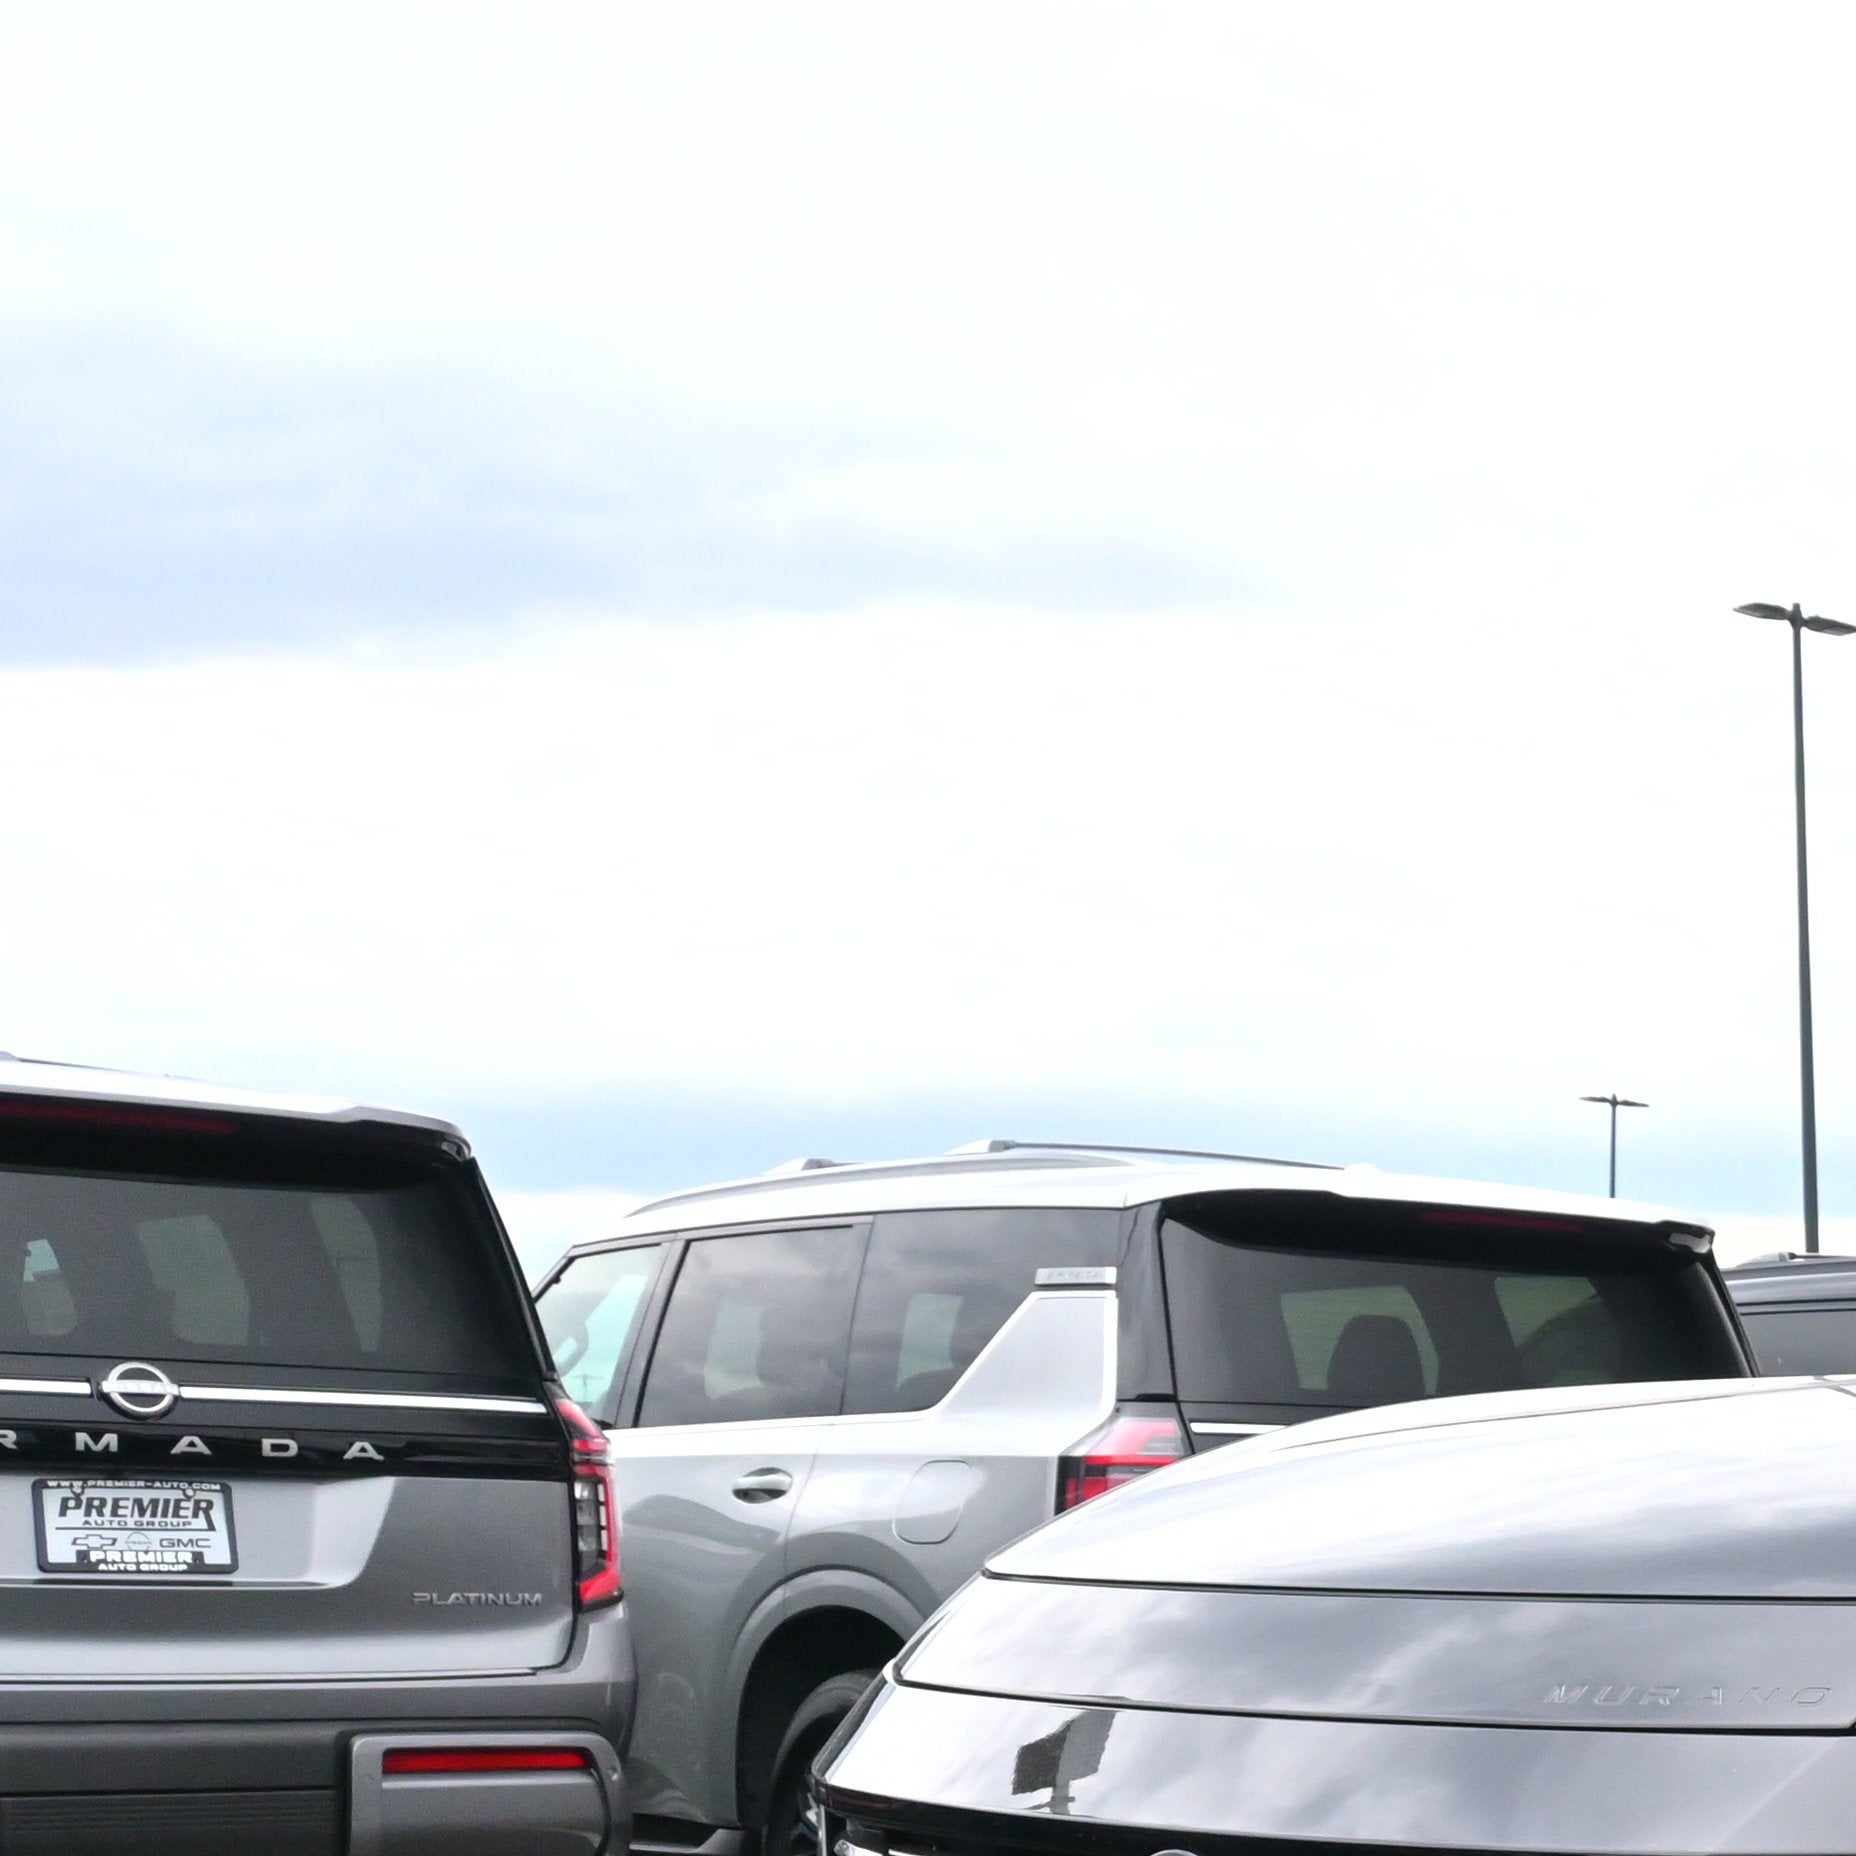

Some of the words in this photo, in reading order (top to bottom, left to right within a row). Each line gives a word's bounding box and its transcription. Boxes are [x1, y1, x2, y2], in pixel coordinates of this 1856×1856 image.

[47, 1480, 221, 1490] WWW.PREMIER-AUTO.COM
[58, 1497, 216, 1529] PREMIER
[82, 1519, 128, 1527] AUTO
[134, 1520, 192, 1528] GROUP
[159, 1538, 212, 1548] GMC
[90, 1551, 193, 1563] PREMIER
[98, 1563, 137, 1571] AUTO
[413, 1592, 542, 1605] PLATINUM
[1541, 1682, 1832, 1708] MURANO
